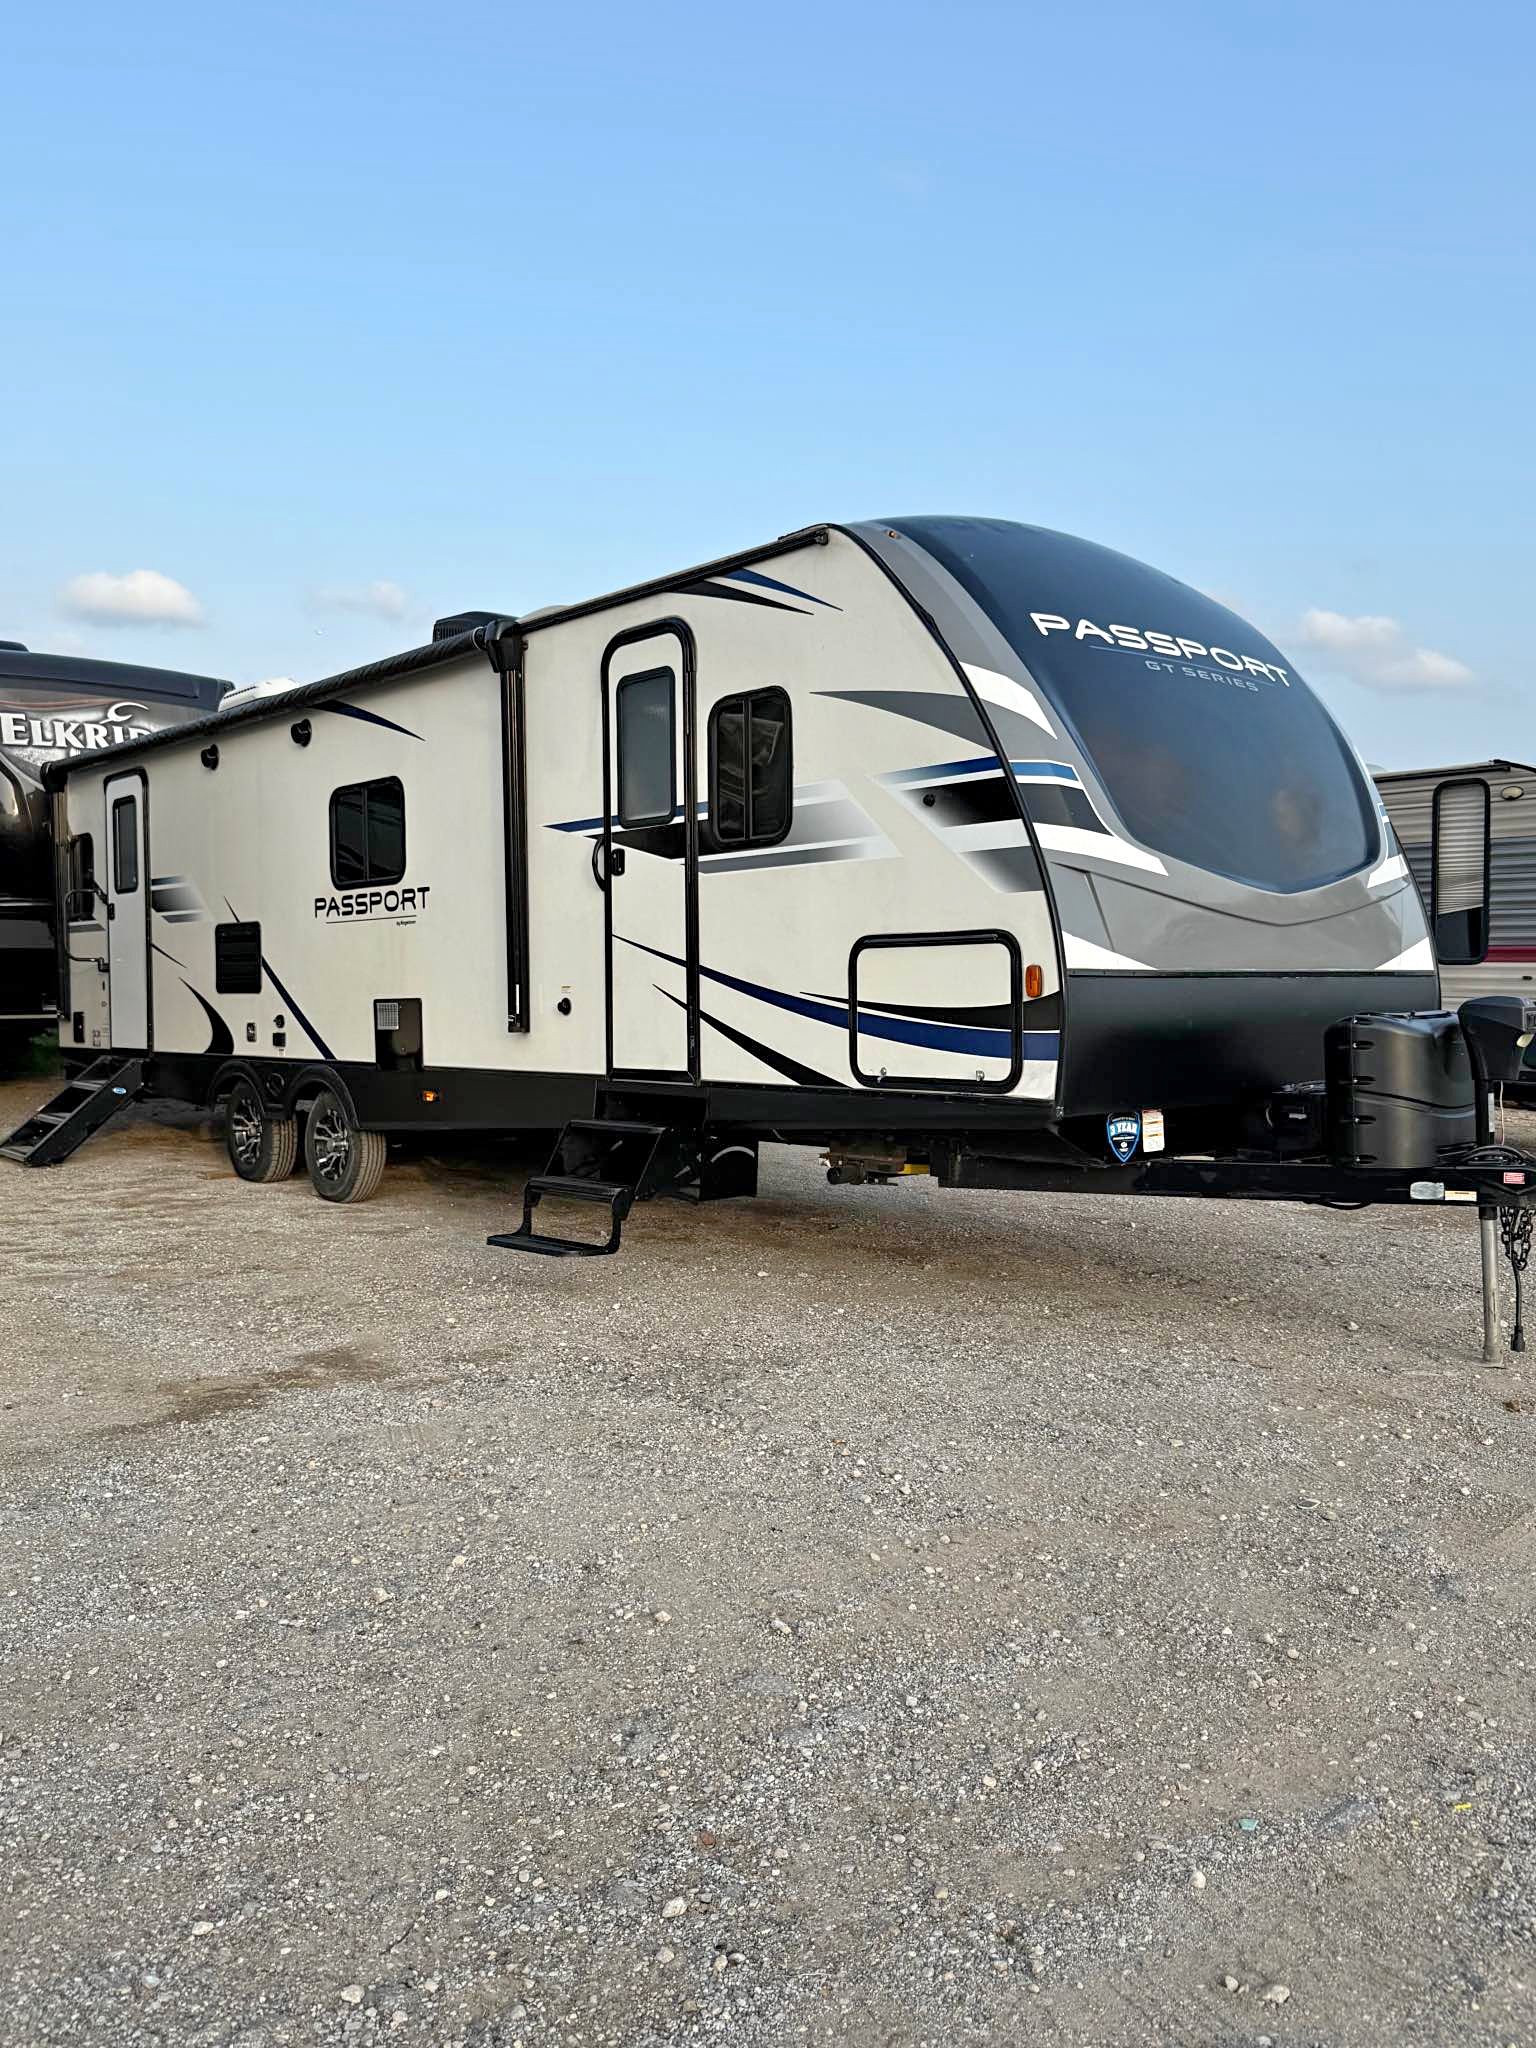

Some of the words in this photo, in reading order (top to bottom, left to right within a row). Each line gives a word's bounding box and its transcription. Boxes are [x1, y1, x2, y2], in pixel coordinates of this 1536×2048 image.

[1030, 612, 1290, 687] PASSPORT
[1144, 660, 1175, 674] GT
[1182, 668, 1259, 692] SERIES
[314, 887, 430, 918] PASSPORT
